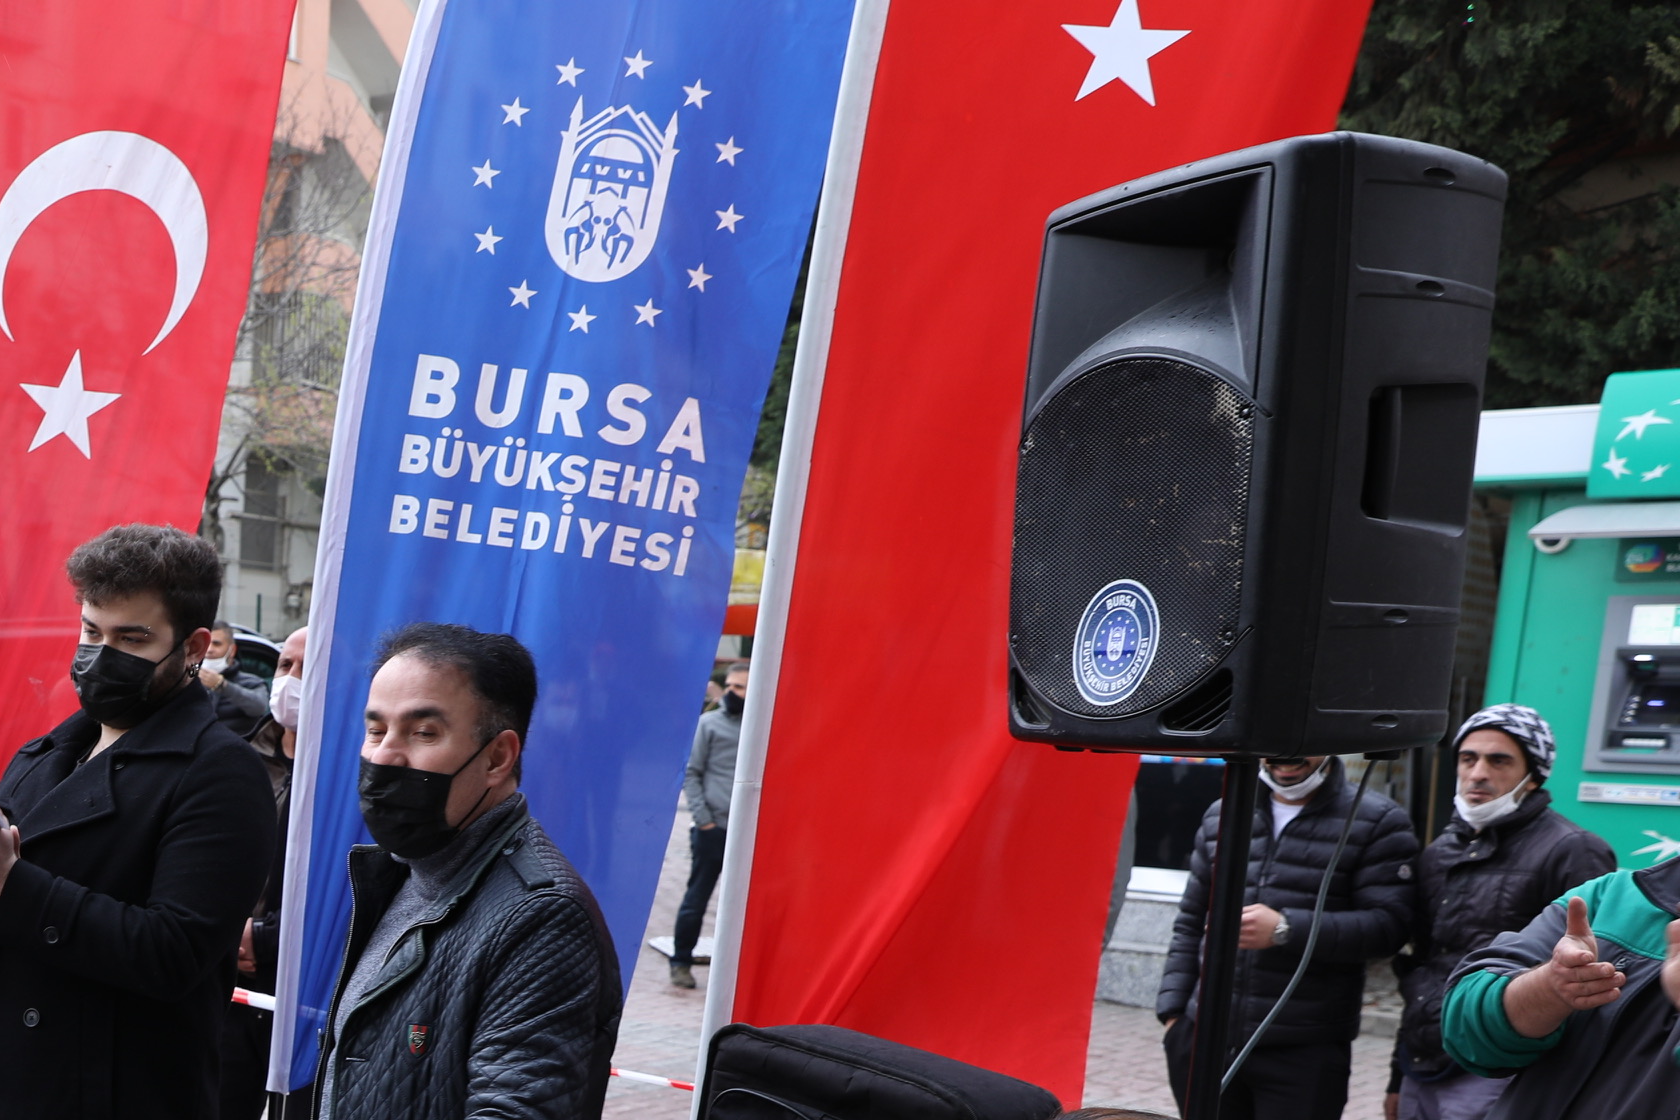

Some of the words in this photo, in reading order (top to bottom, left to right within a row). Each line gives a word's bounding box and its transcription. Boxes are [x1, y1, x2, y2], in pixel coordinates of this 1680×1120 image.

[408, 353, 706, 463] BURSA
[398, 426, 701, 518] BÜYÜKŞEHİR
[389, 502, 694, 576] BELEDİYESİ
[1105, 595, 1137, 611] BURSA
[1083, 641, 1109, 692] BÜYÜKŞEHİR
